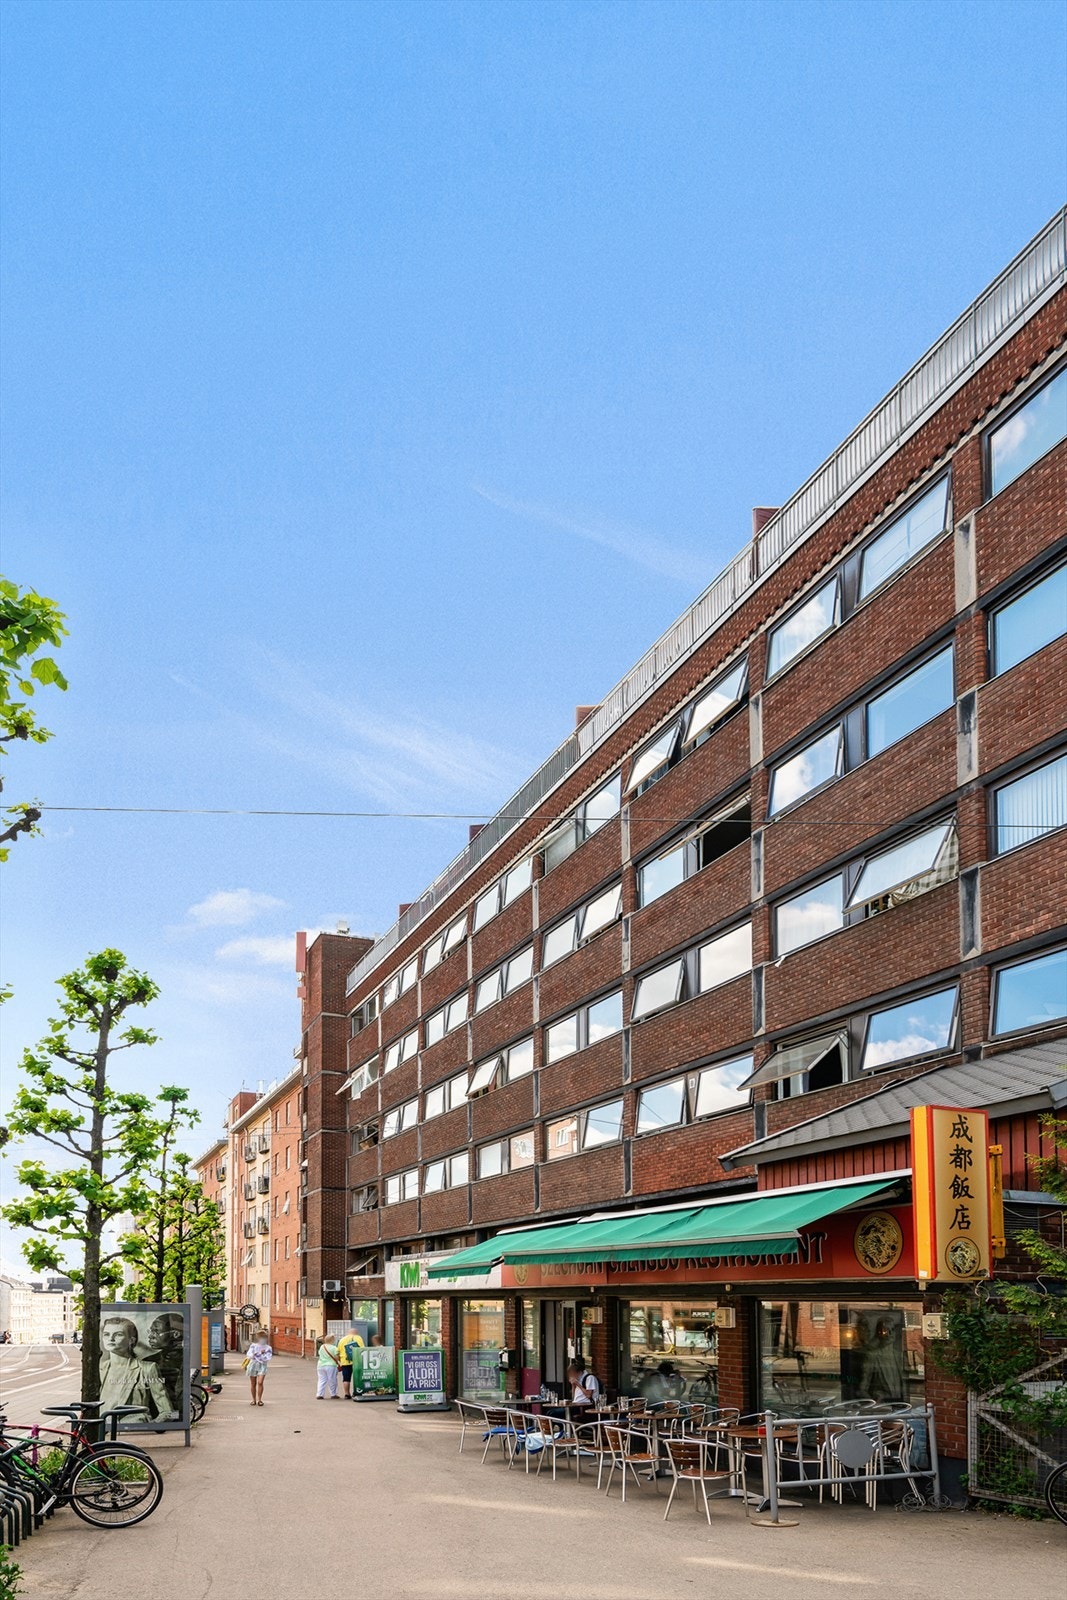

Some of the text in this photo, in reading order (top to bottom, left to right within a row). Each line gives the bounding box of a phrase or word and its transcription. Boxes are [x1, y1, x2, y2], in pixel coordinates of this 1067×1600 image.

[949, 1114, 975, 1231] 成都飯店
[400, 1261, 420, 1288] KIWI
[408, 1368, 438, 1380] ALDRI
